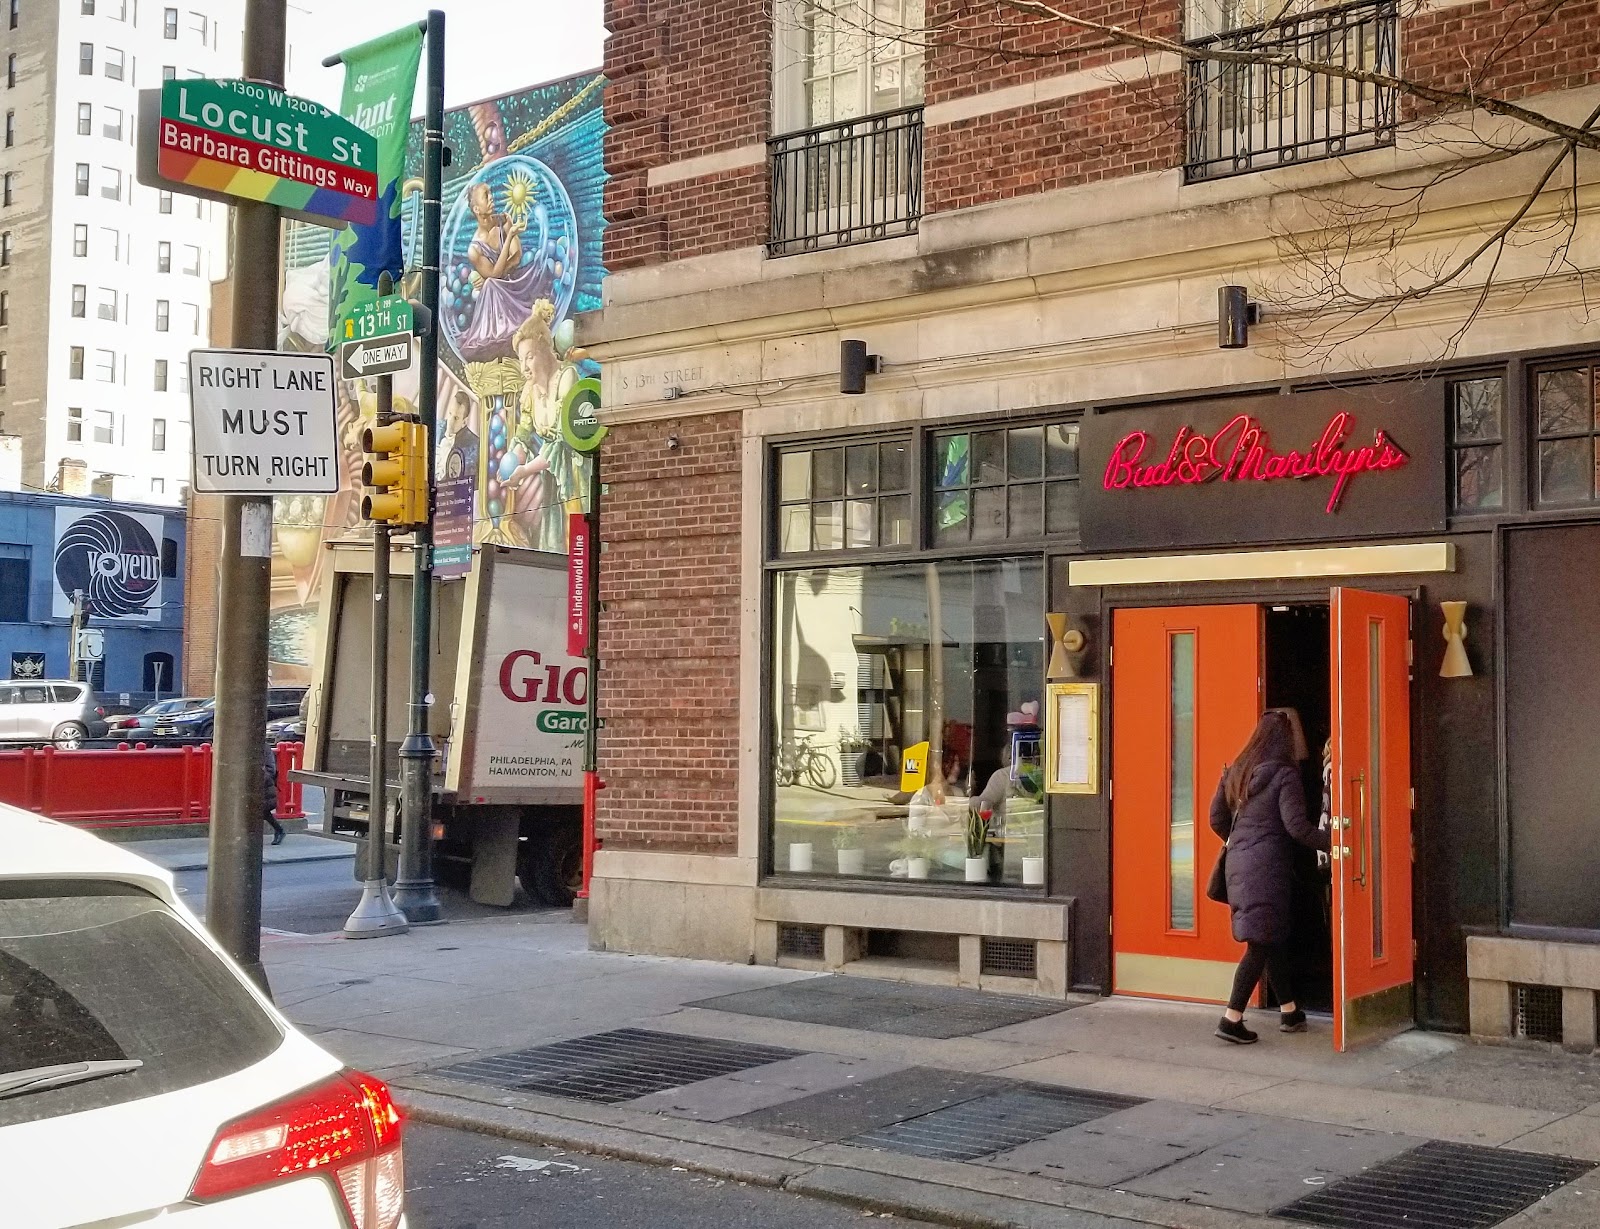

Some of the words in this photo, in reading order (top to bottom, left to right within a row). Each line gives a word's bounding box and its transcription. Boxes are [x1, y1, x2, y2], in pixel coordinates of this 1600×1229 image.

[232, 81, 265, 100] 1300
[268, 89, 284, 108] W
[286, 97, 317, 115] 1200
[346, 93, 397, 131] lant
[179, 88, 308, 152] Locust
[332, 136, 362, 166] St
[376, 121, 396, 138] CITY
[164, 123, 250, 165] Barbara
[257, 149, 337, 187] Gittings
[343, 176, 372, 198] Way
[375, 301, 380, 312] S
[359, 311, 391, 337] 13TH
[397, 314, 407, 330] ST
[363, 350, 381, 365] ONE
[384, 345, 404, 360] WAY
[199, 366, 262, 389] RIGHT
[273, 369, 327, 391] LANE
[622, 377, 629, 390] S
[663, 366, 704, 384] STREET
[222, 408, 308, 436] MUST
[203, 455, 260, 476] TURN
[271, 456, 329, 477] RIGHT
[1103, 425, 1189, 490] Bud
[1178, 435, 1210, 484] &
[1210, 412, 1404, 515] Marilyn's
[575, 535, 584, 557] Line
[87, 551, 160, 584] voyeur
[573, 559, 583, 617] Lindenwold
[489, 767, 558, 777] HAMMONTON,
[561, 768, 572, 777] NJ
[490, 756, 558, 767] PHILADELPHIA,
[561, 758, 572, 766] PA
